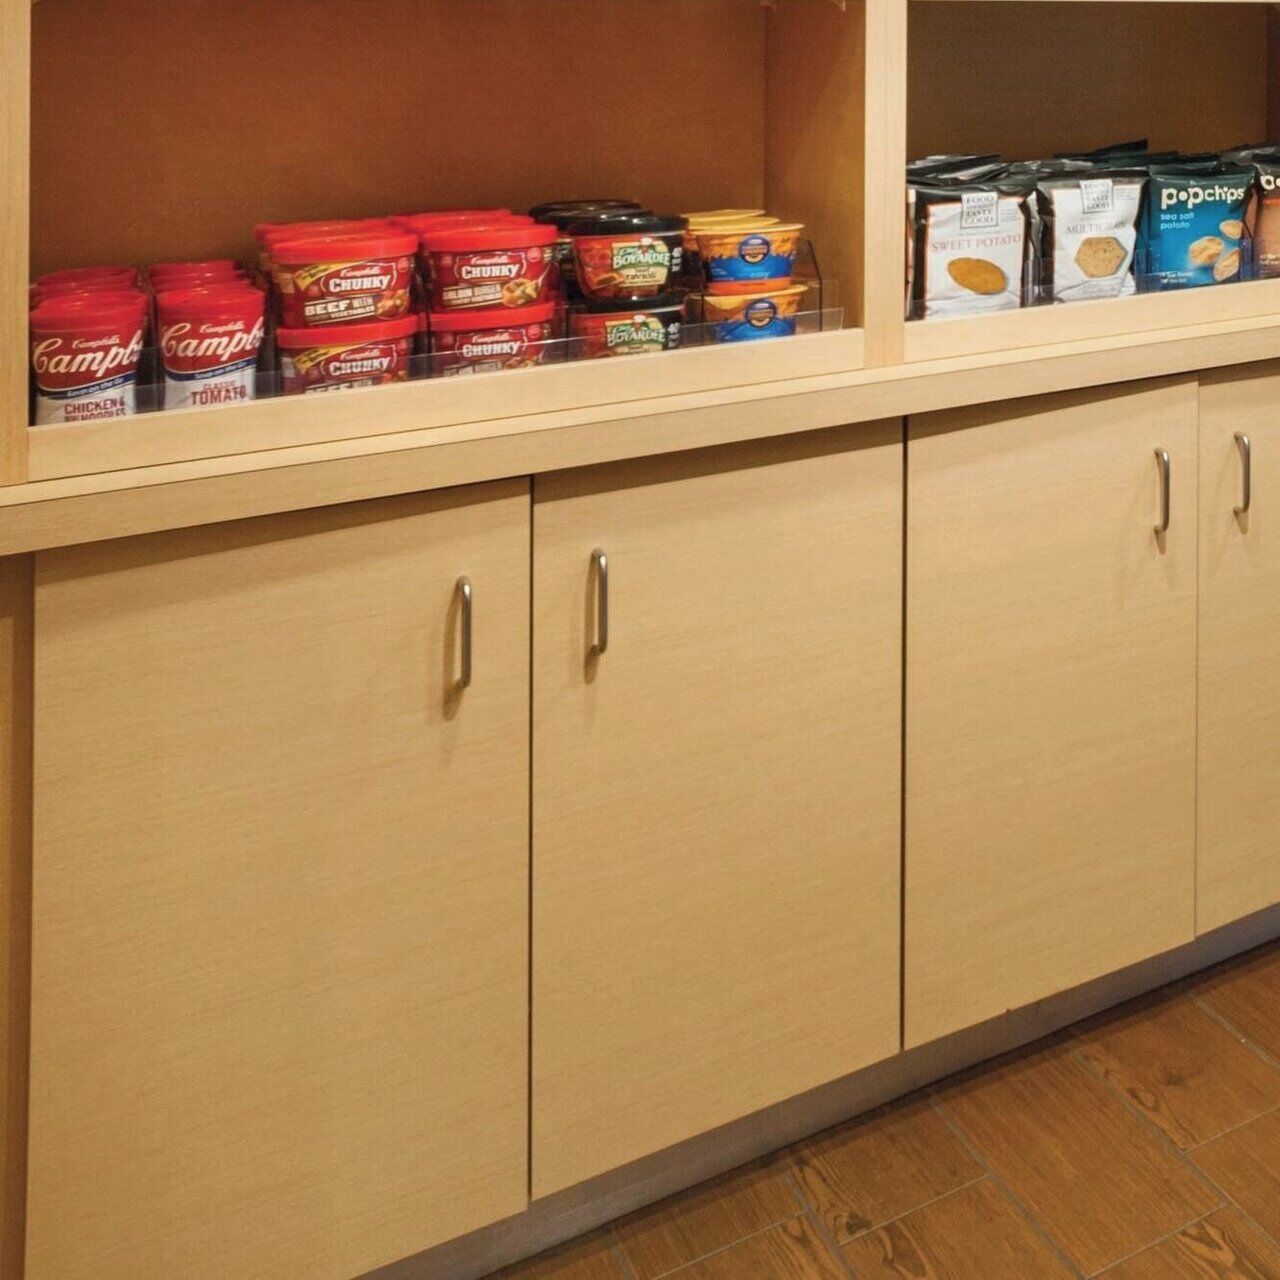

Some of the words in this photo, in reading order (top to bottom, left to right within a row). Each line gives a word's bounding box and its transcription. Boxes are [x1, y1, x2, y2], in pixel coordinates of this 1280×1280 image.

[966, 195, 995, 204] FOOD
[1160, 185, 1246, 210] popchips
[965, 216, 994, 225] GOOD
[1160, 213, 1177, 221] sea
[1179, 212, 1195, 220] salt
[1160, 221, 1191, 230] potato
[932, 237, 972, 252] SWEET
[977, 234, 1022, 248] POTATO
[612, 252, 672, 268] BOYARDEE
[461, 263, 520, 279] CHUNKY
[329, 274, 391, 293] CHUNKY
[304, 300, 351, 316] BEEF
[462, 340, 522, 358] CHUNKY
[329, 357, 391, 376] CHUNKY
[190, 386, 247, 406] TOMATO
[64, 399, 117, 415] CHICKEN
